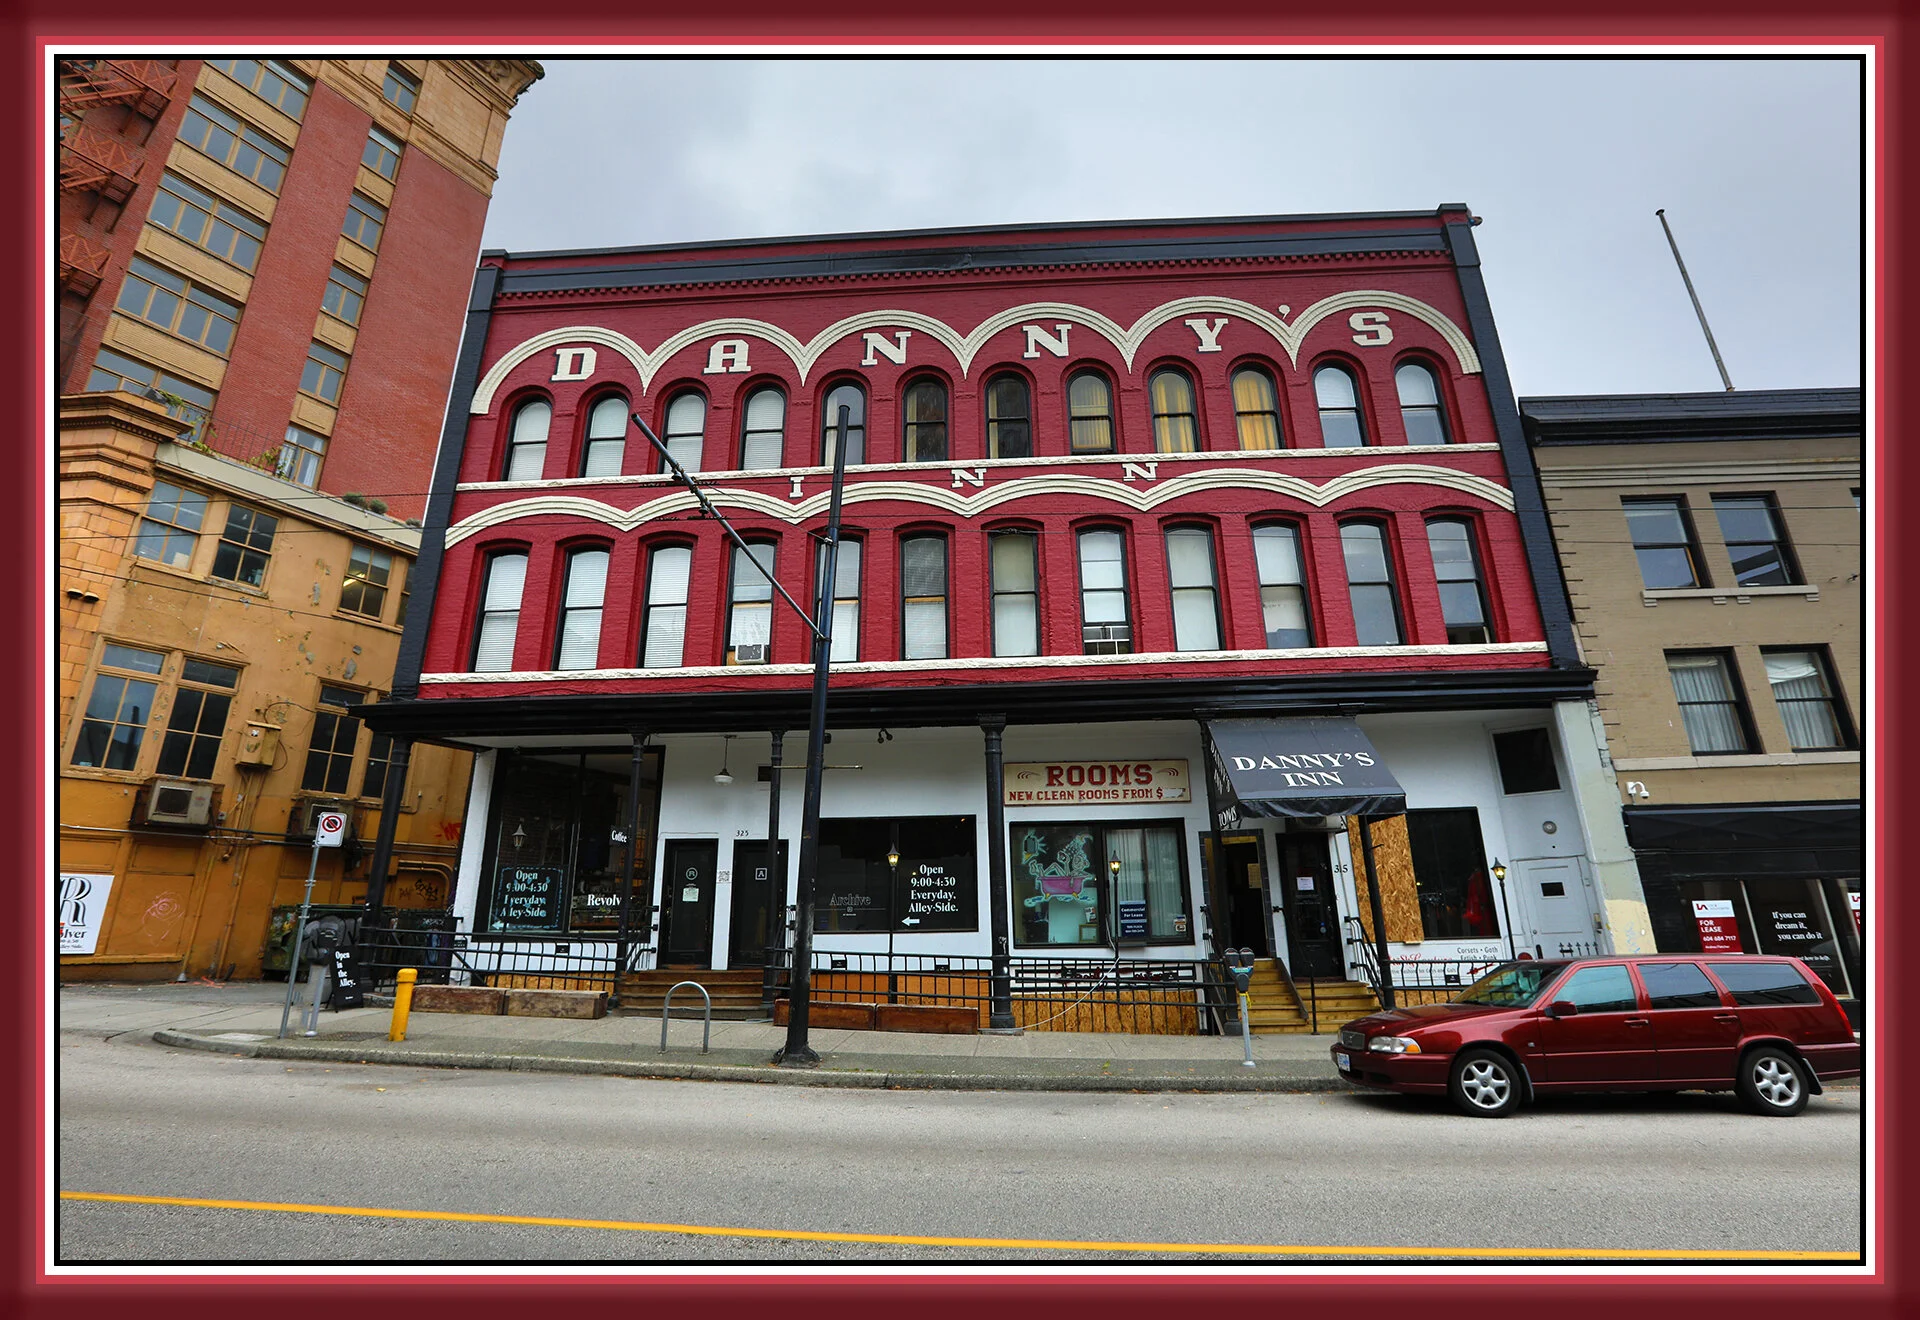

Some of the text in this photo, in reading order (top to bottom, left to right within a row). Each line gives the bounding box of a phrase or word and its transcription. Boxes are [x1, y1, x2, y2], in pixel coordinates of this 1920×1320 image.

[1231, 751, 1375, 772] DANNY'S
[1046, 764, 1153, 787] ROOMS
[1281, 771, 1345, 788] INN
[1037, 790, 1074, 800] CLEAN
[1078, 789, 1119, 799] ROOMS
[1123, 788, 1153, 799] FROM
[611, 829, 628, 843] Coffee
[515, 869, 539, 882] Open
[919, 864, 944, 876] Open
[910, 876, 956, 887] 9:00-4:30
[587, 894, 623, 906] Revolv
[829, 893, 872, 906] Archive
[910, 889, 957, 901] Everyday.
[908, 902, 959, 914] Alley-Side.
[1775, 922, 1799, 930] dream
[1777, 933, 1792, 941] you
[1806, 931, 1816, 939] do
[335, 951, 350, 961] Open
